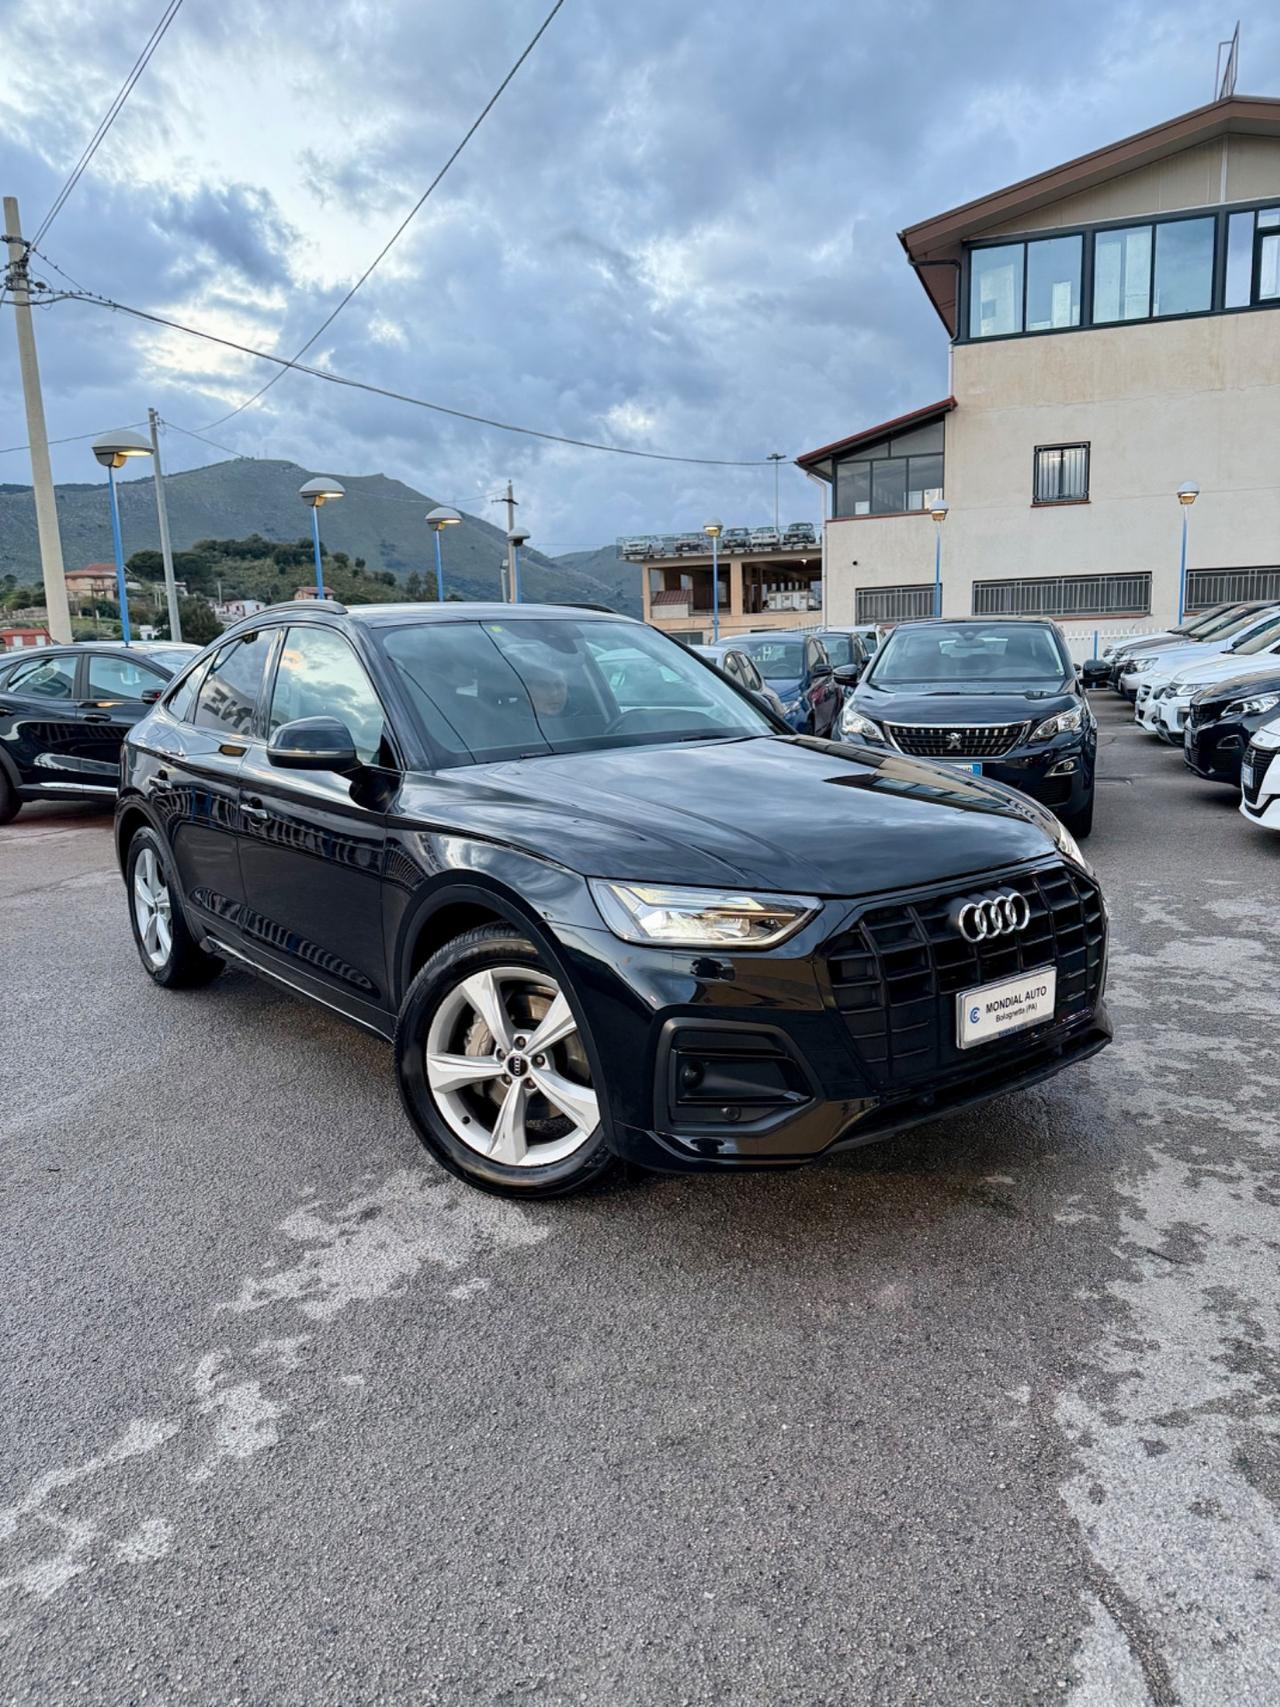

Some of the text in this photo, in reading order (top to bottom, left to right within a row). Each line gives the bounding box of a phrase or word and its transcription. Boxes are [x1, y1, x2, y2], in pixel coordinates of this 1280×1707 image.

[986, 986, 1047, 1014] MONDIAL AUTO
[1026, 1002, 1038, 1014] (PA)
